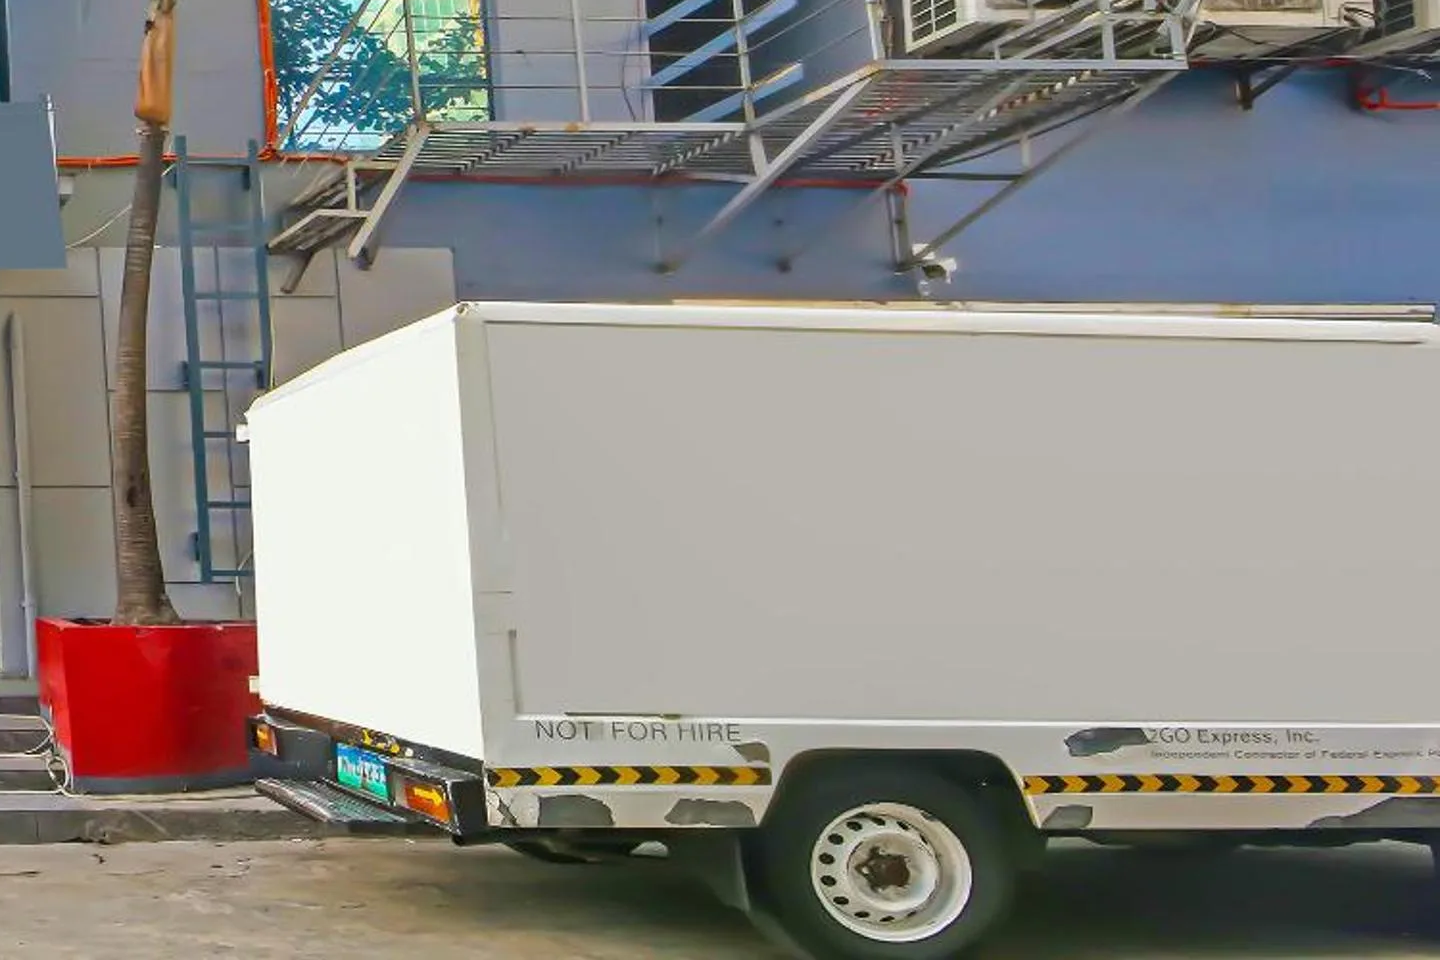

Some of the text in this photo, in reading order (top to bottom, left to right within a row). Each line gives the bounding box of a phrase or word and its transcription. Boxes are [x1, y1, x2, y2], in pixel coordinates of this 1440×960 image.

[534, 719, 742, 743] NOT FOR HIRE
[1197, 728, 1279, 746] Express,
[1285, 728, 1321, 744] Inc.
